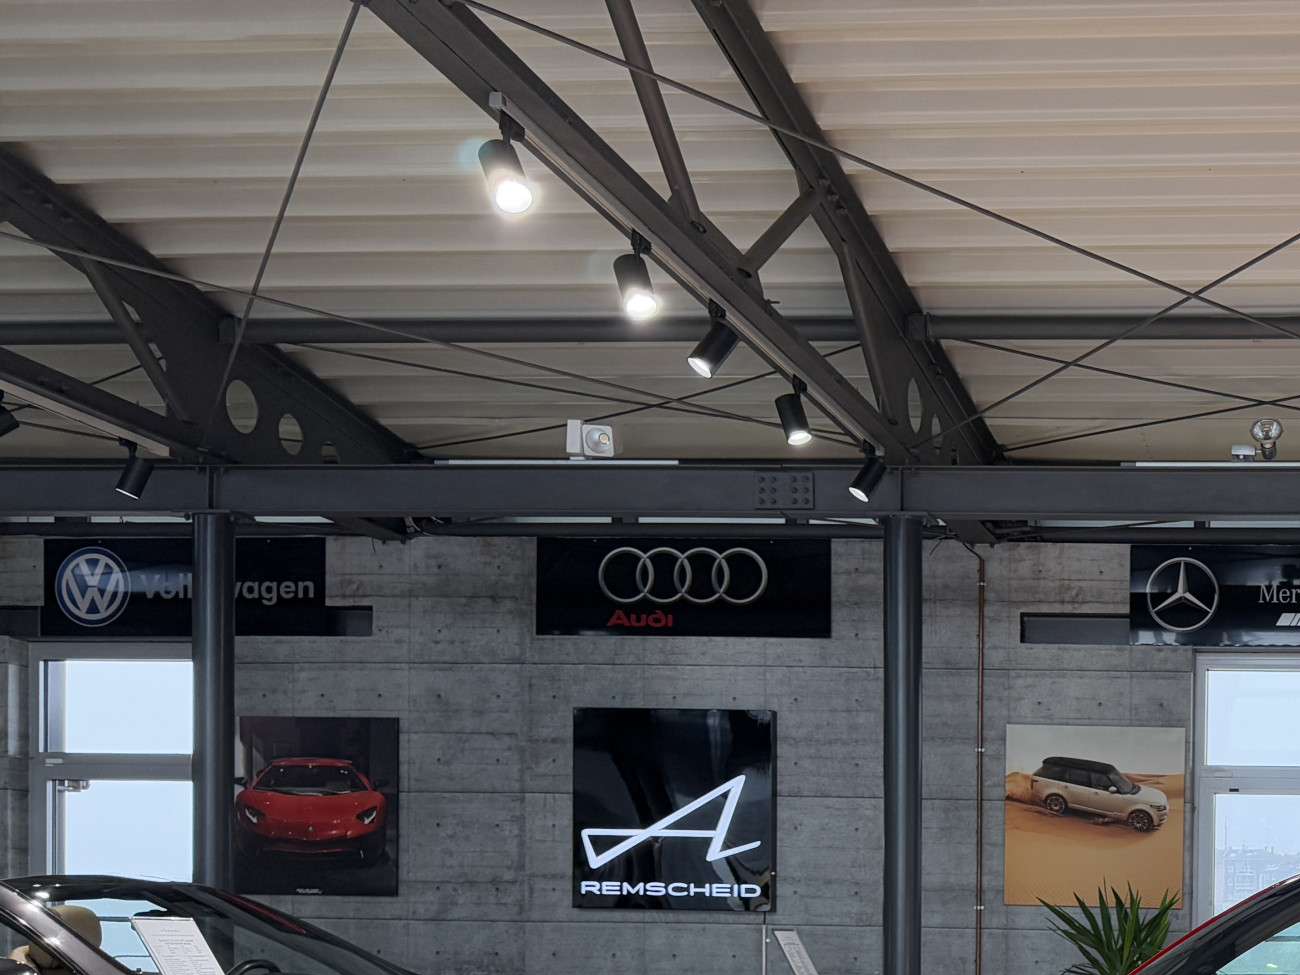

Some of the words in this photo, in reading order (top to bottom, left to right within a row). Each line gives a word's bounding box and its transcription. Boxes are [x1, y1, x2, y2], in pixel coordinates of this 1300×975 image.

[142, 572, 314, 605] Volagen
[607, 609, 673, 628] Audi
[580, 881, 762, 898] REMSCHEID
